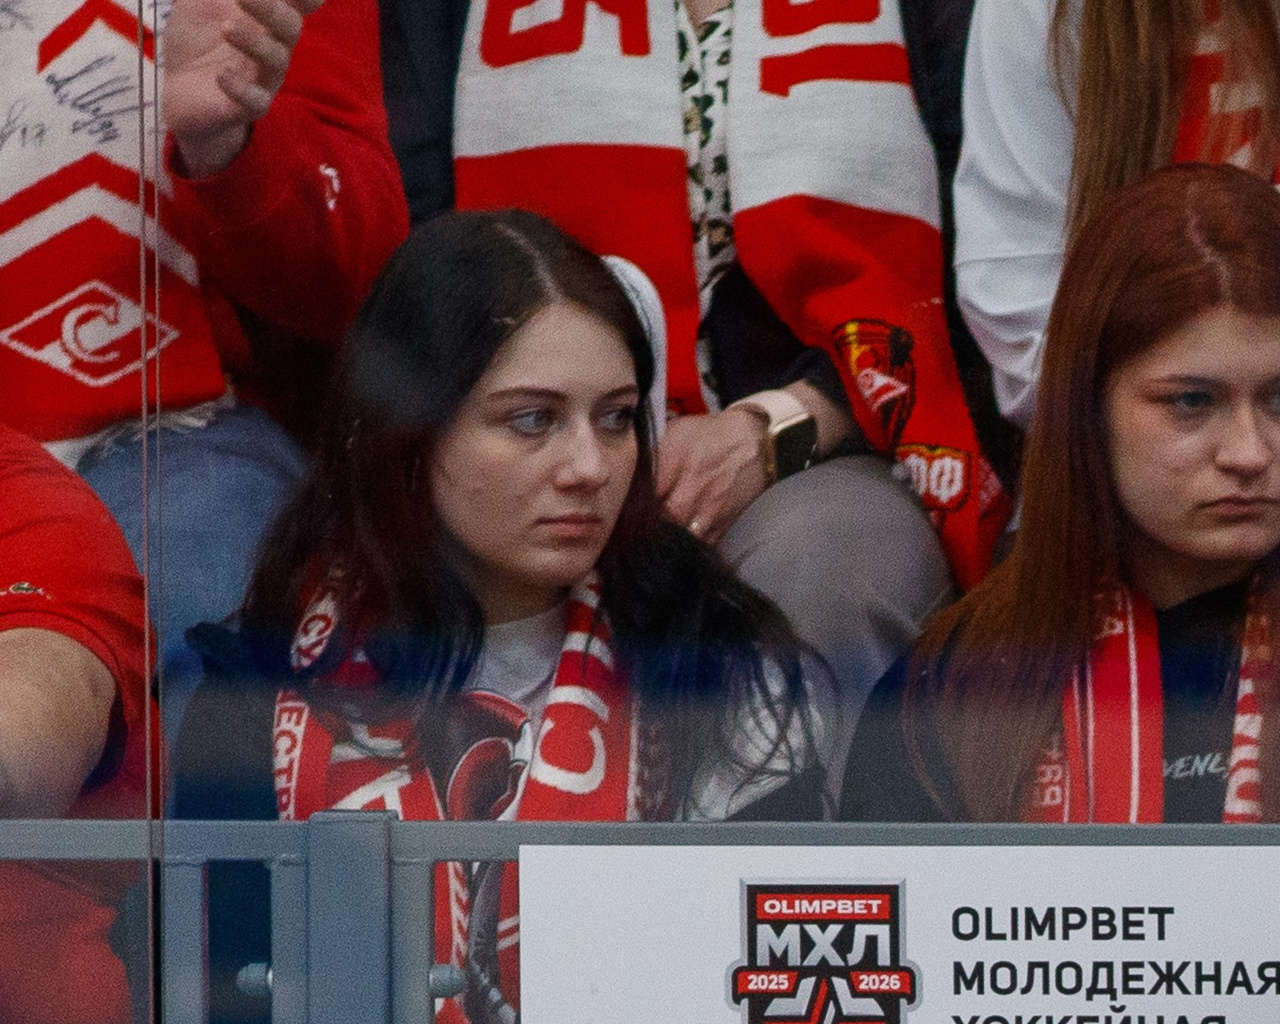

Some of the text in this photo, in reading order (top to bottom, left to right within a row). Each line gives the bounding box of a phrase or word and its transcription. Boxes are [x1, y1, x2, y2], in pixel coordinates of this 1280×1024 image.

[763, 898, 882, 915] OLIMPBET
[952, 906, 1175, 941] OLIMPBET
[756, 923, 891, 967] МХЛ
[747, 974, 901, 990] 2025 2026
